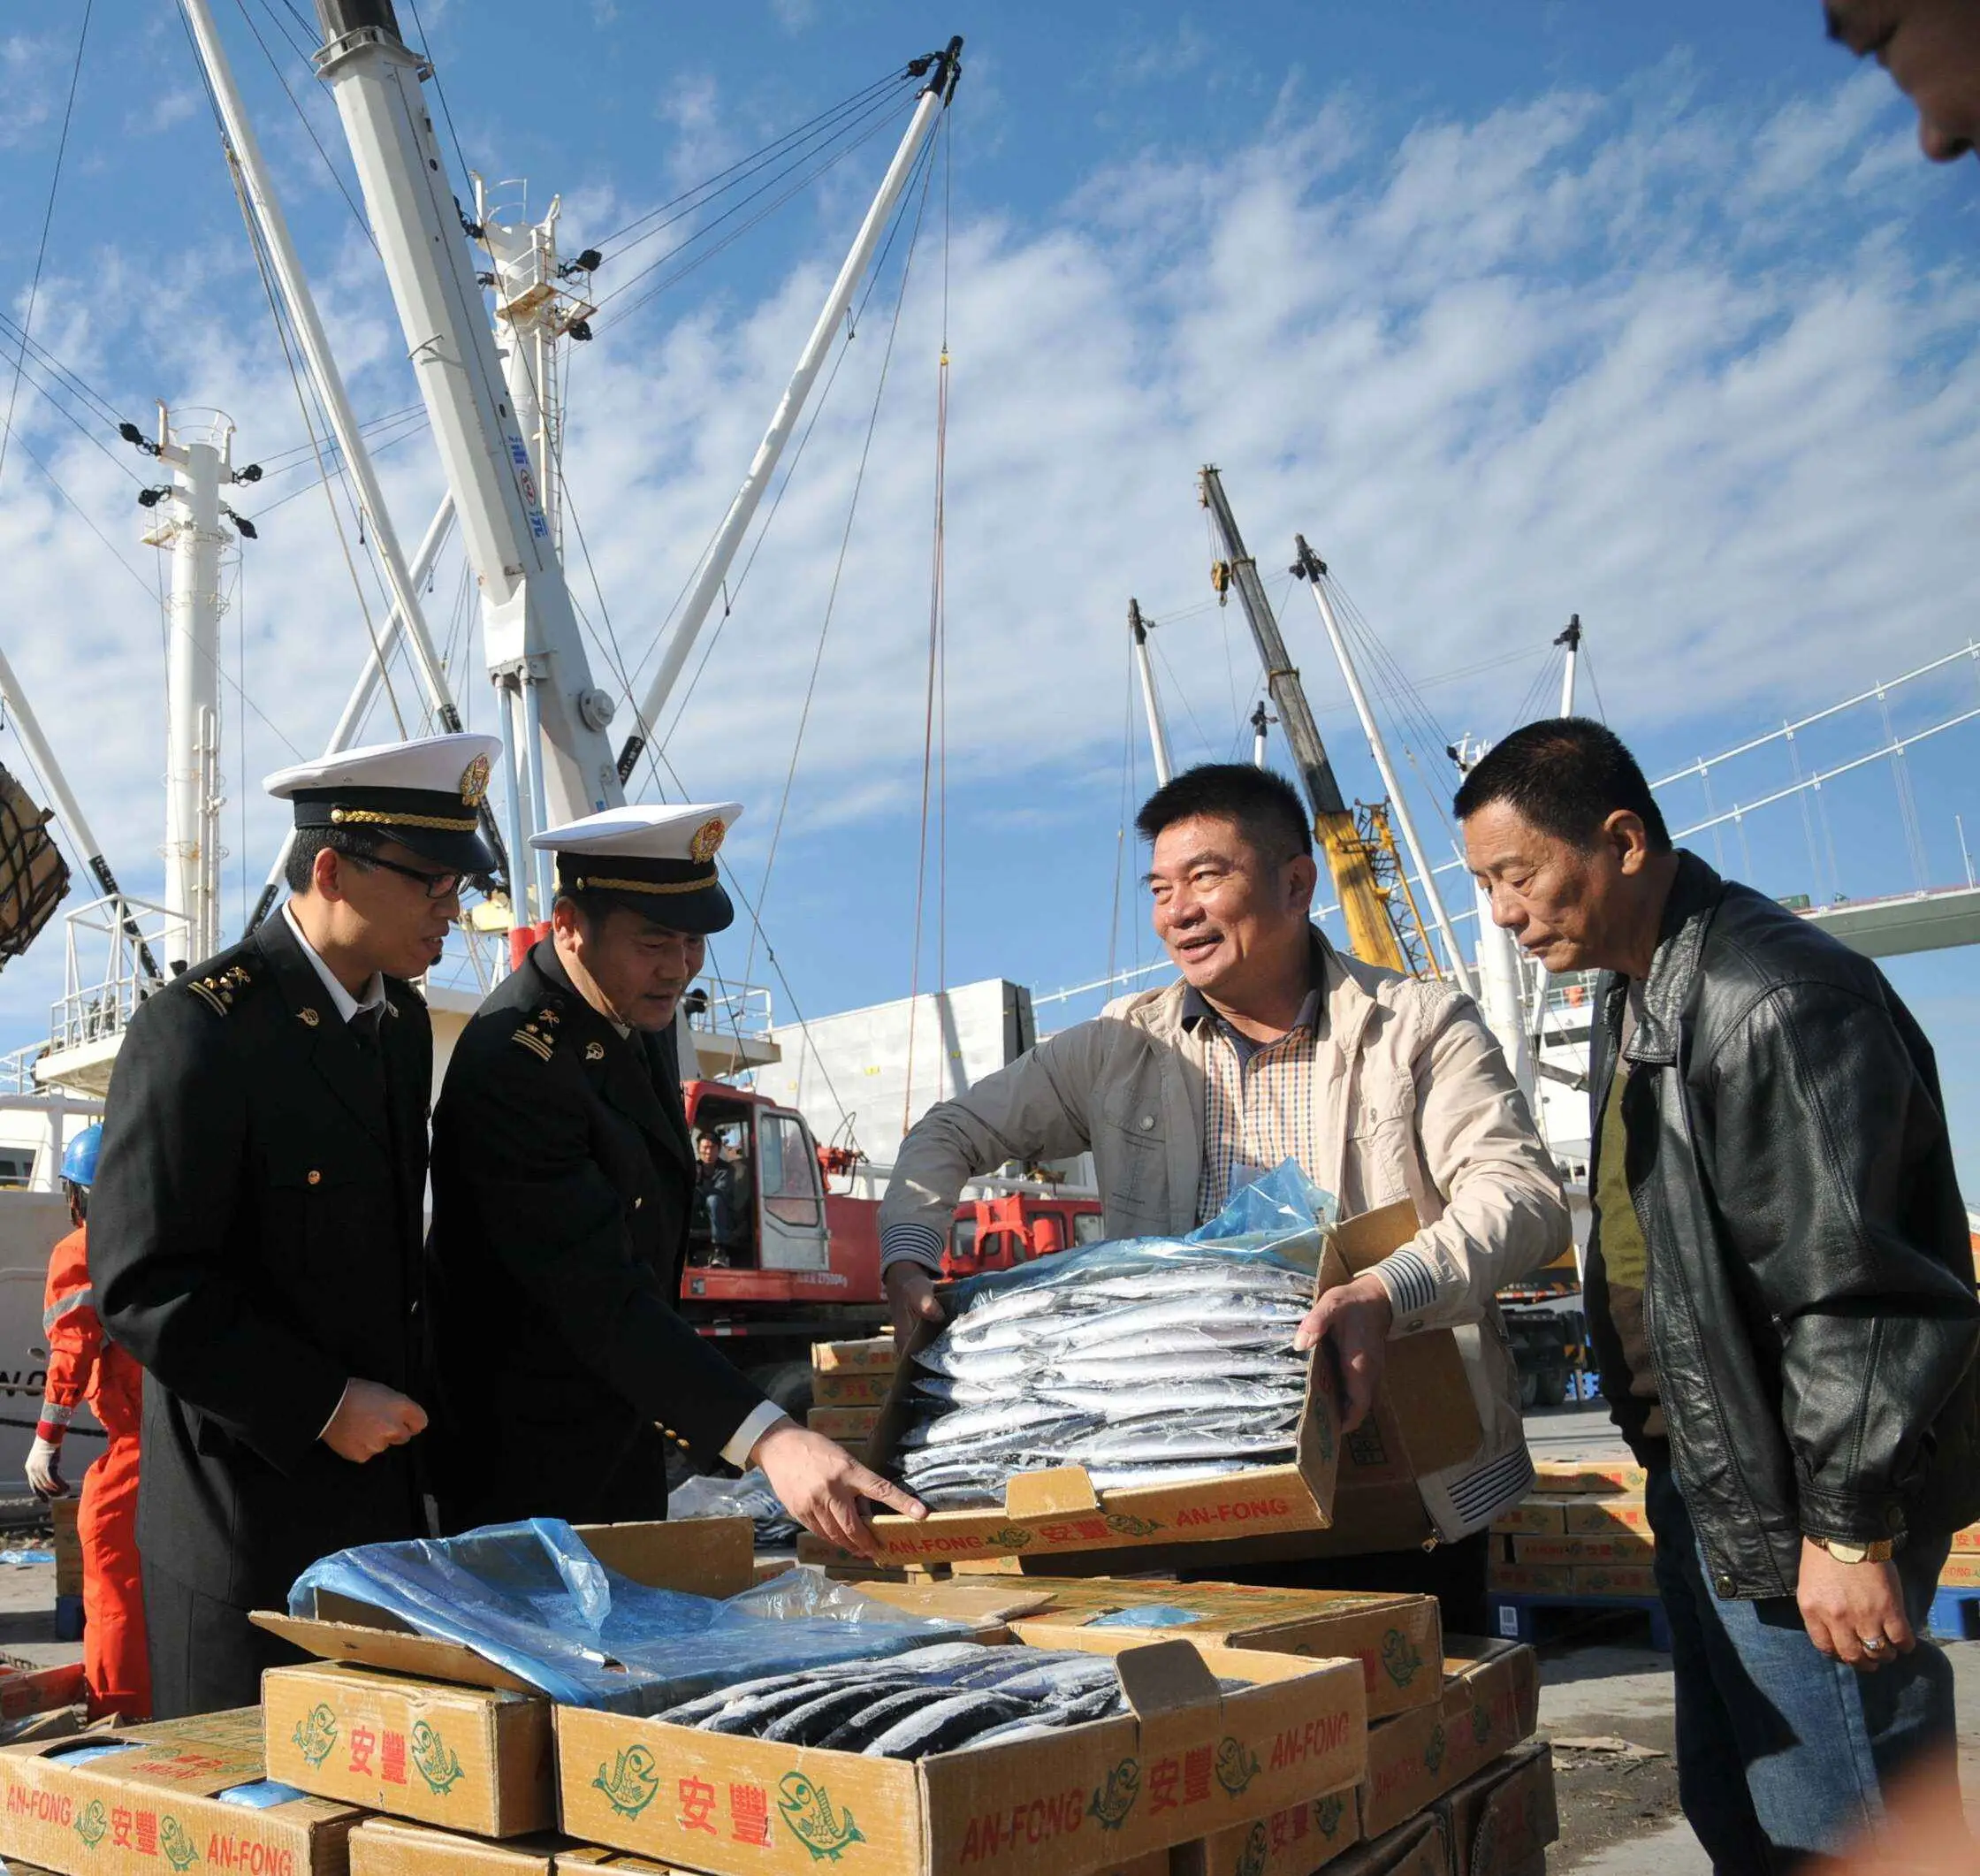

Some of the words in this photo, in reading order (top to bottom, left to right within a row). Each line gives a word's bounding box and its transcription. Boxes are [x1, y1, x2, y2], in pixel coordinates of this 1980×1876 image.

[887, 1536, 982, 1555] AN-FONG
[1176, 1499, 1289, 1527] AN-FONG
[348, 1725, 407, 1785] 安豐
[960, 1788, 1084, 1865] AN-FONG
[1148, 1743, 1213, 1817] 安豐
[1268, 1712, 1349, 1769] AN-FONG
[6, 1783, 73, 1828] AN-FONG
[111, 1805, 159, 1857] 安豐
[206, 1832, 293, 1876] AN-FONG
[679, 1775, 772, 1849] 安豐
